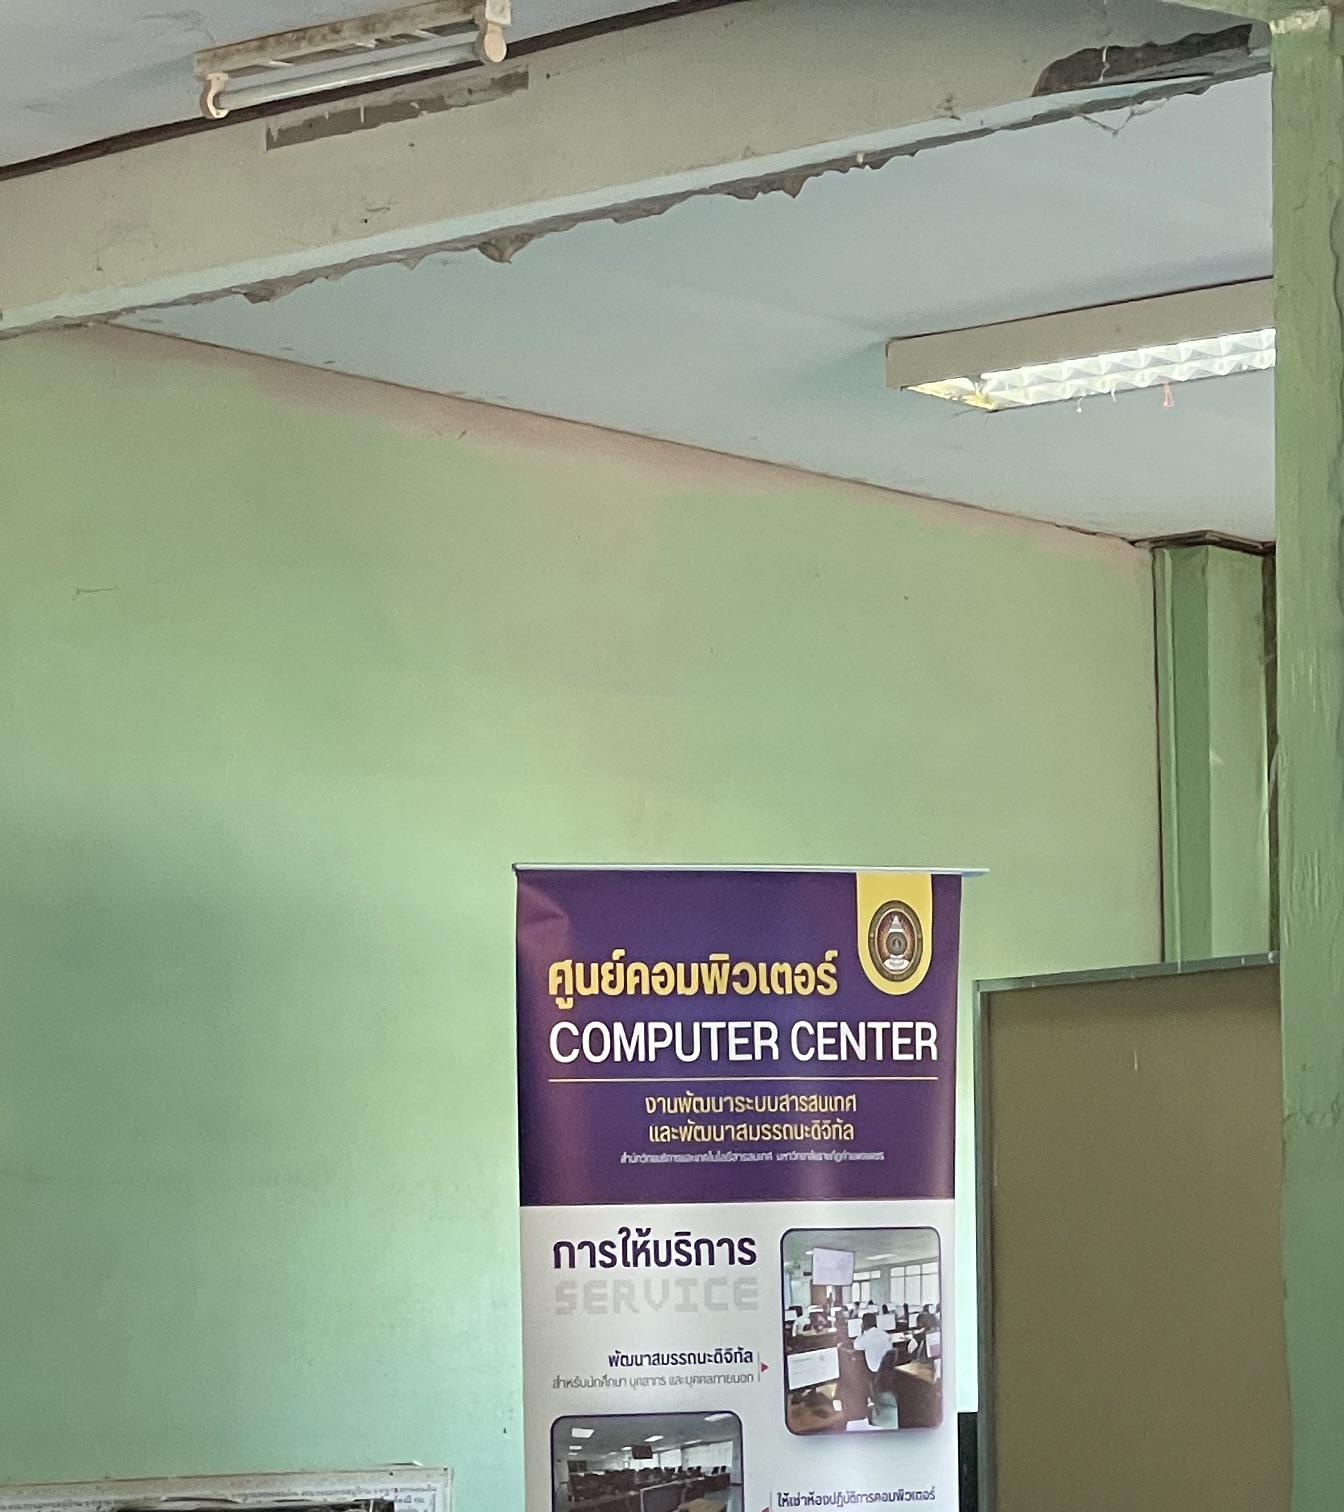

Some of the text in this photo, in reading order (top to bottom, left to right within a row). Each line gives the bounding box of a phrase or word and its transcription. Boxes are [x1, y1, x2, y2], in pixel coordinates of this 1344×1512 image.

[549, 949, 839, 1010] ศูนย์คอมพิวเตอร์
[549, 1020, 938, 1063] COMPUTER CENTER
[645, 1090, 856, 1114] งานพัฒนาระบบสารสนเทศ
[649, 1119, 854, 1142] และพัฒนาสมรรถนะดิจิทัล
[553, 1227, 757, 1269] การให้บริการ
[556, 1277, 758, 1315] SERVICE
[608, 1346, 753, 1367] พัฒนาสมรรถนะดิจิทัล
